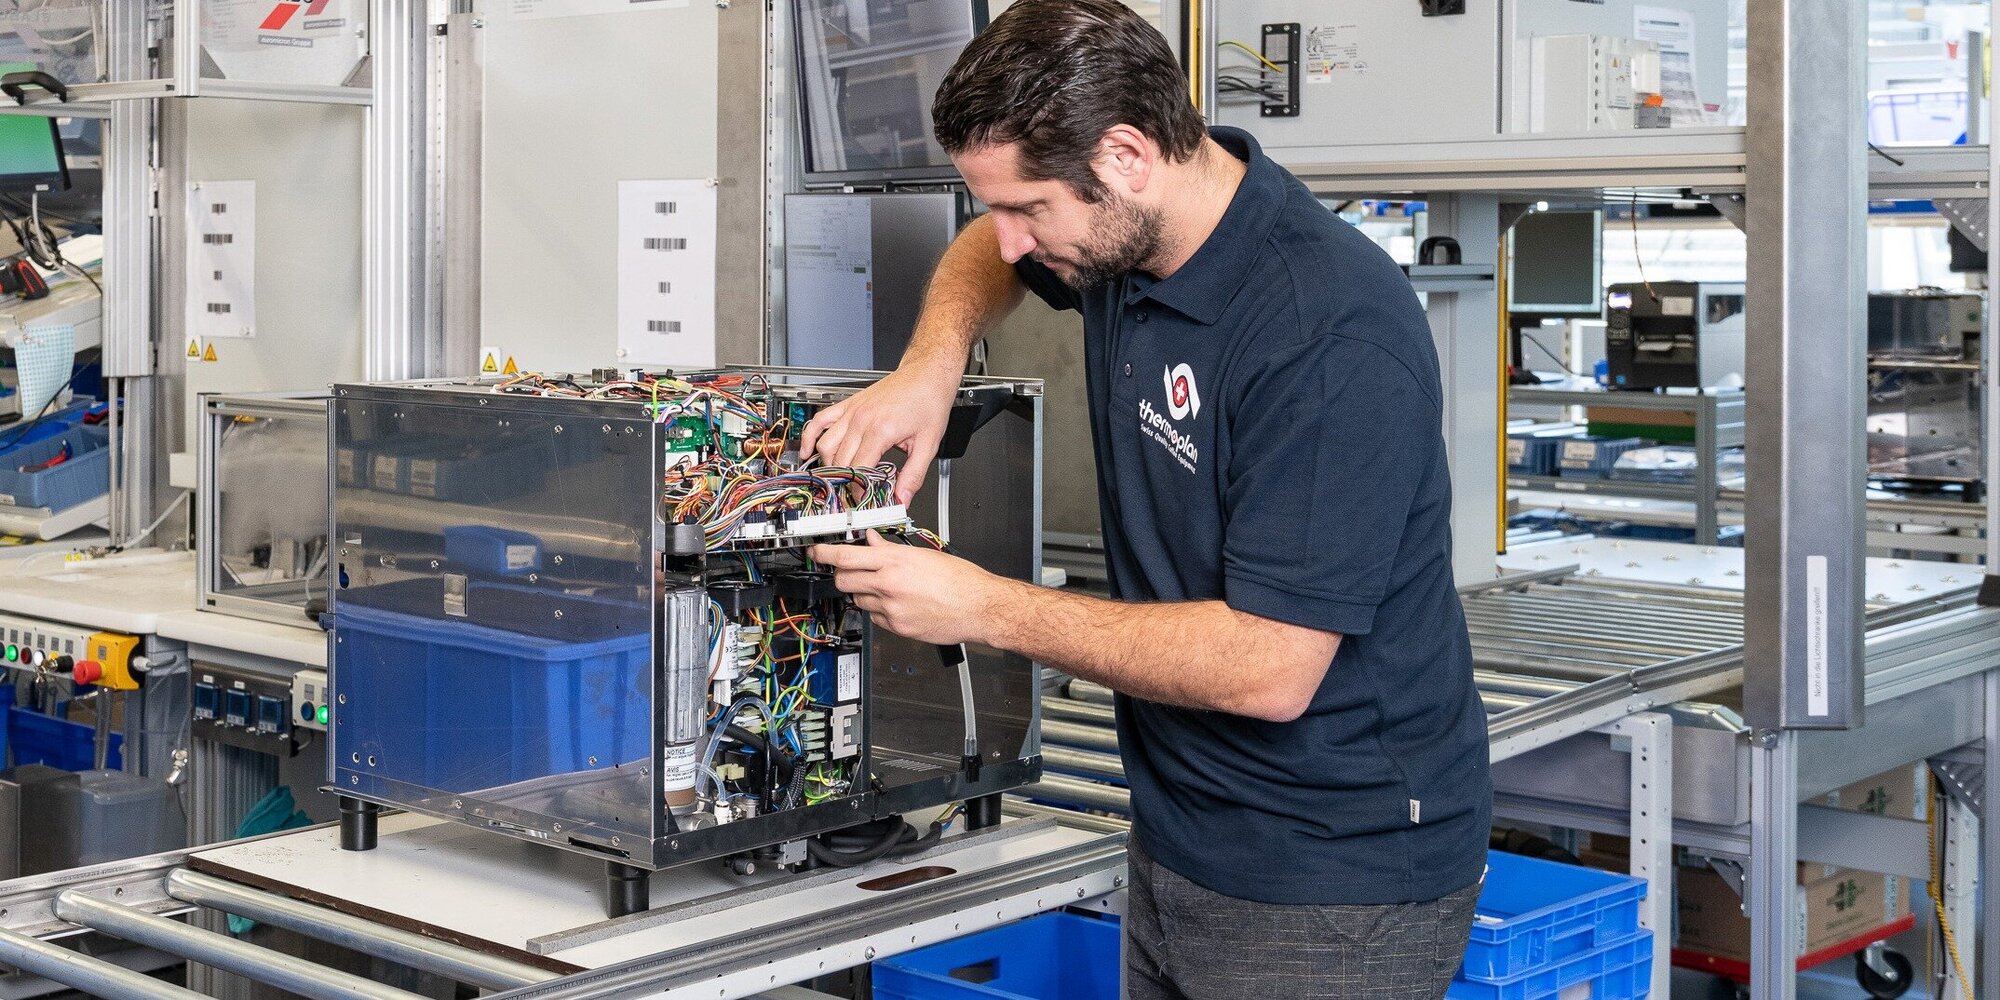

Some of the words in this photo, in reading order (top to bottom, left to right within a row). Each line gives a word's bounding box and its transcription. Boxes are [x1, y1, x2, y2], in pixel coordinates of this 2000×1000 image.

[1139, 399, 1198, 463] thermoplan
[1140, 423, 1154, 437] Swiss
[1154, 432, 1168, 449] Quality
[1813, 617, 1821, 661] Lichtschranke
[1814, 680, 1822, 698] Nicht
